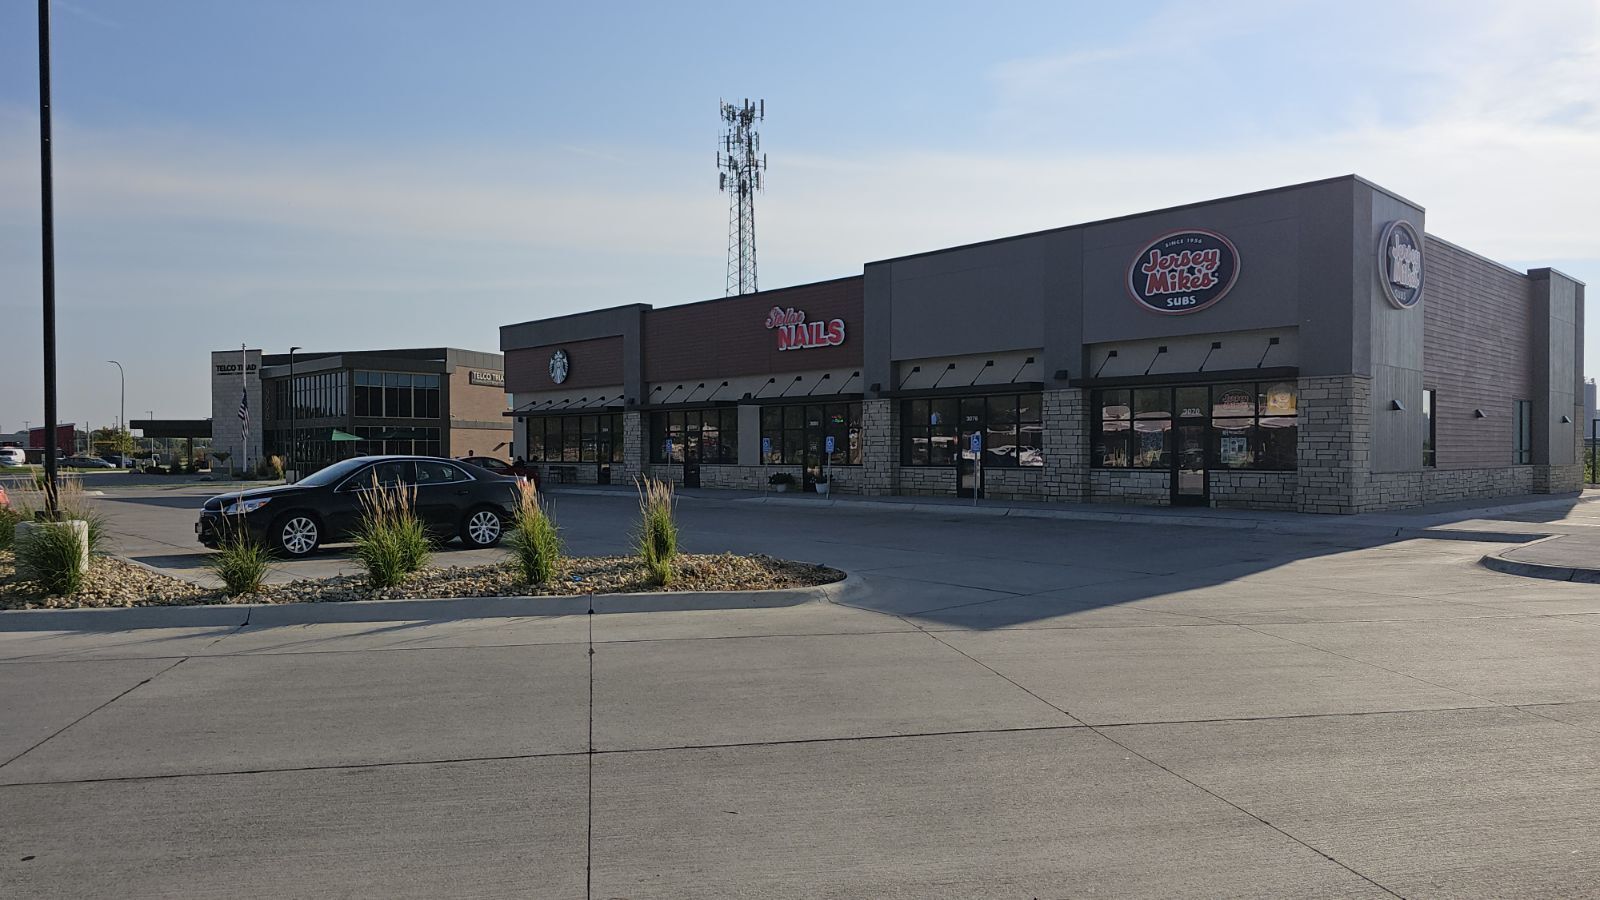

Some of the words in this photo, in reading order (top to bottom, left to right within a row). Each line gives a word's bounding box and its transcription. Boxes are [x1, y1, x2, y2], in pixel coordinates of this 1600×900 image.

[1165, 239, 1184, 248] SINCE
[1142, 249, 1219, 273] Jersey
[1145, 267, 1218, 296] Mike's
[1166, 295, 1196, 307] SUBS
[778, 319, 845, 350] NAILS
[216, 364, 236, 372] TELCO
[473, 372, 492, 380] TELCO
[492, 374, 504, 382] TRIA
